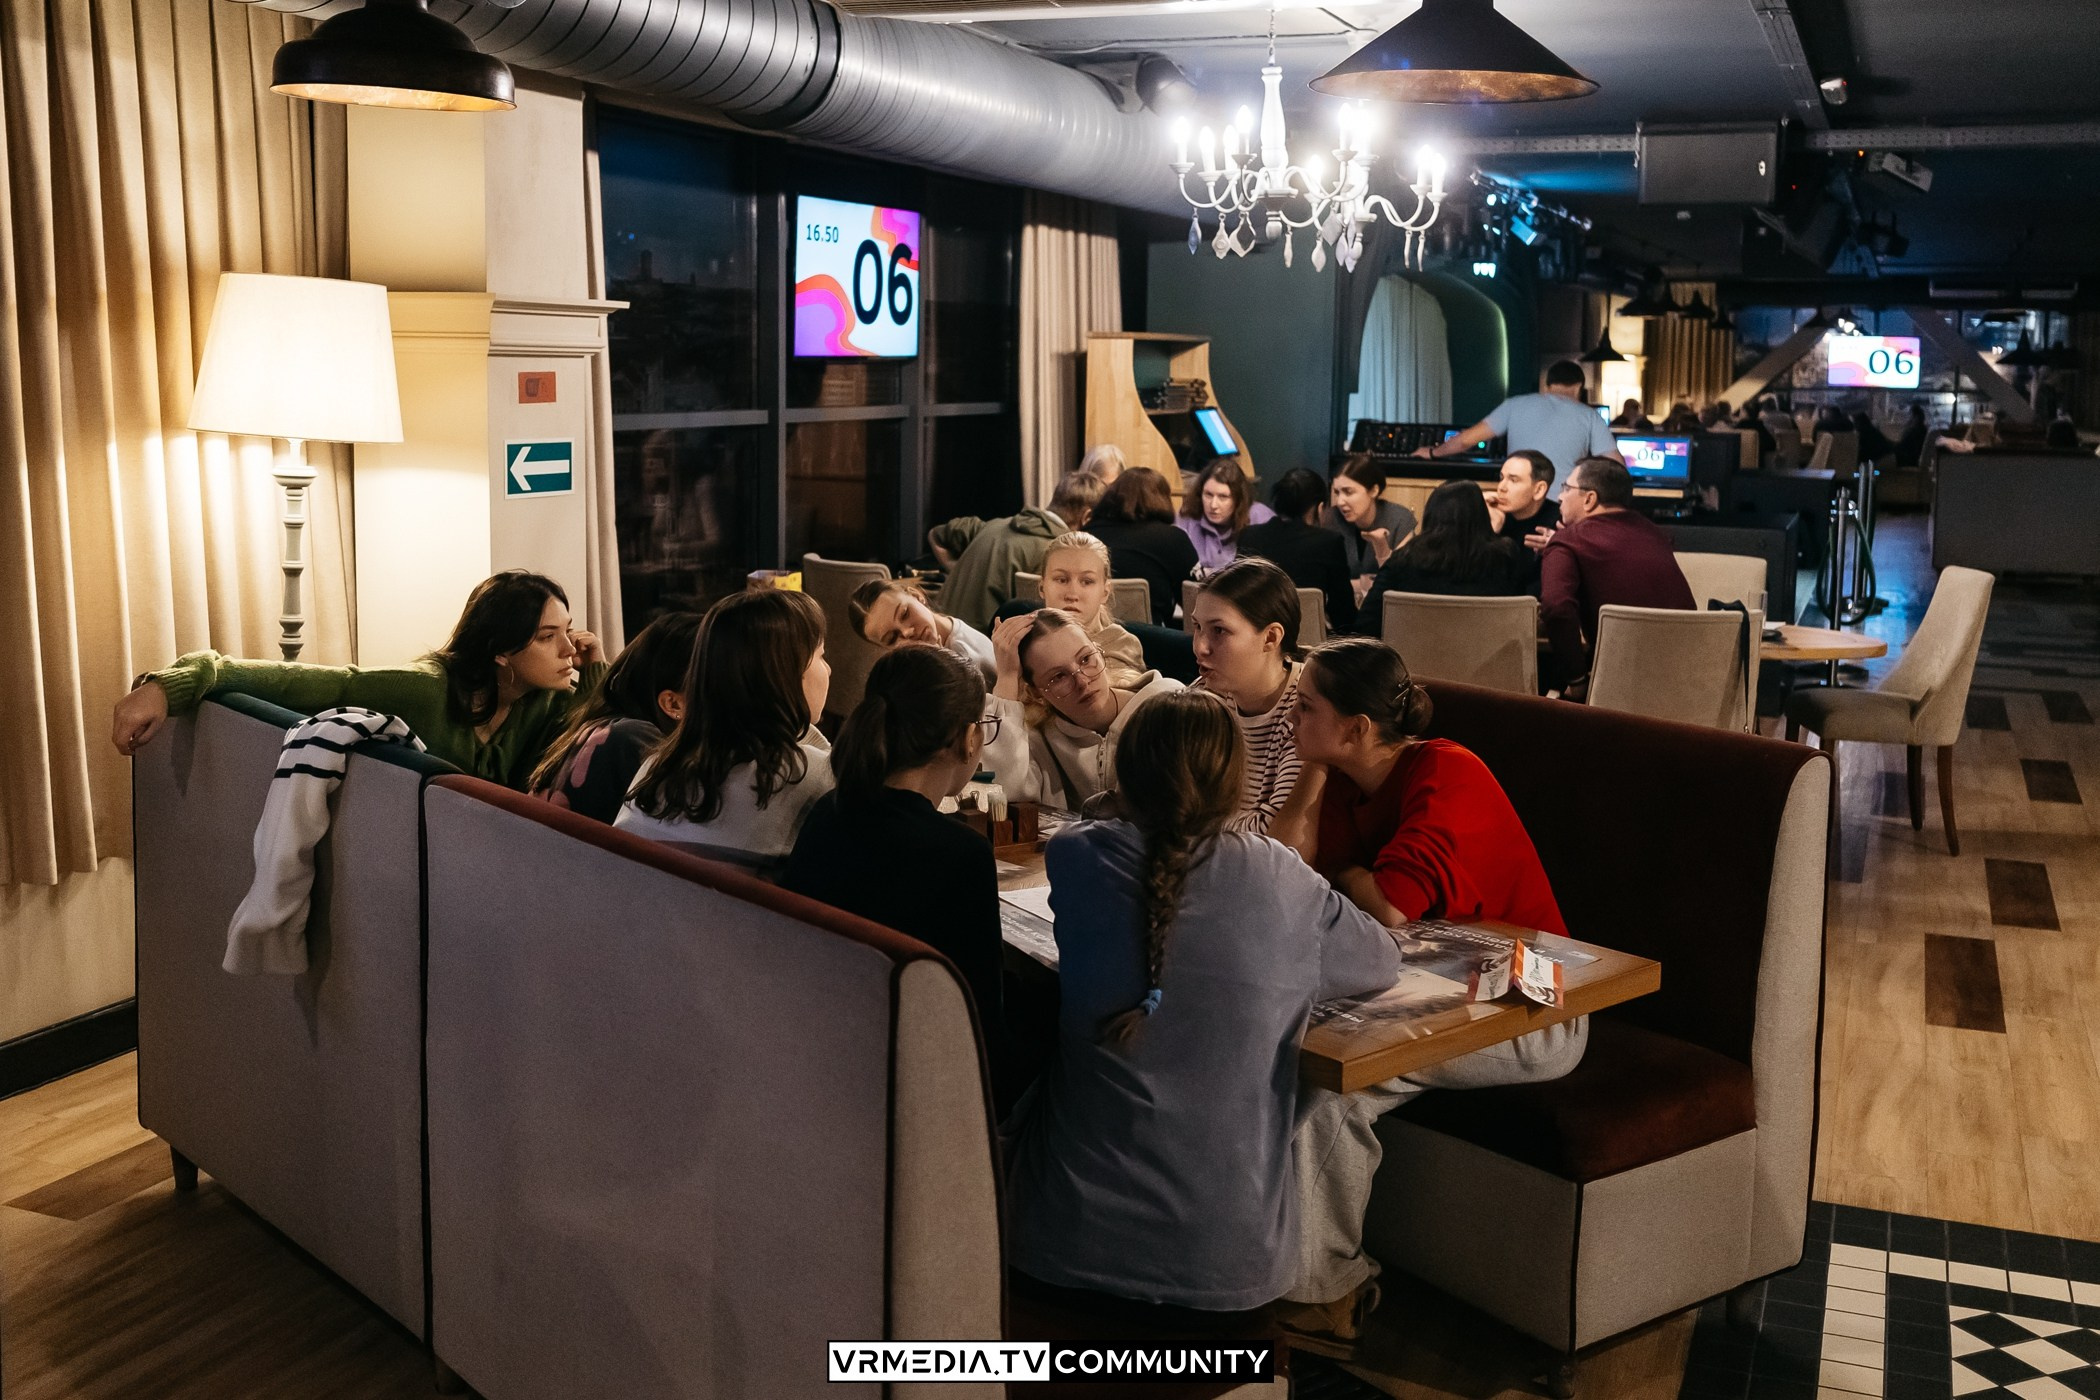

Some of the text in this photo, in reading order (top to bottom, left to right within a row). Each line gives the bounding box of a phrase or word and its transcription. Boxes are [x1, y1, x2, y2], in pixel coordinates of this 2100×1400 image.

[806, 223, 839, 243] 16.50
[853, 239, 912, 326] 06
[1868, 349, 1914, 375] 06
[1637, 447, 1660, 462] 06
